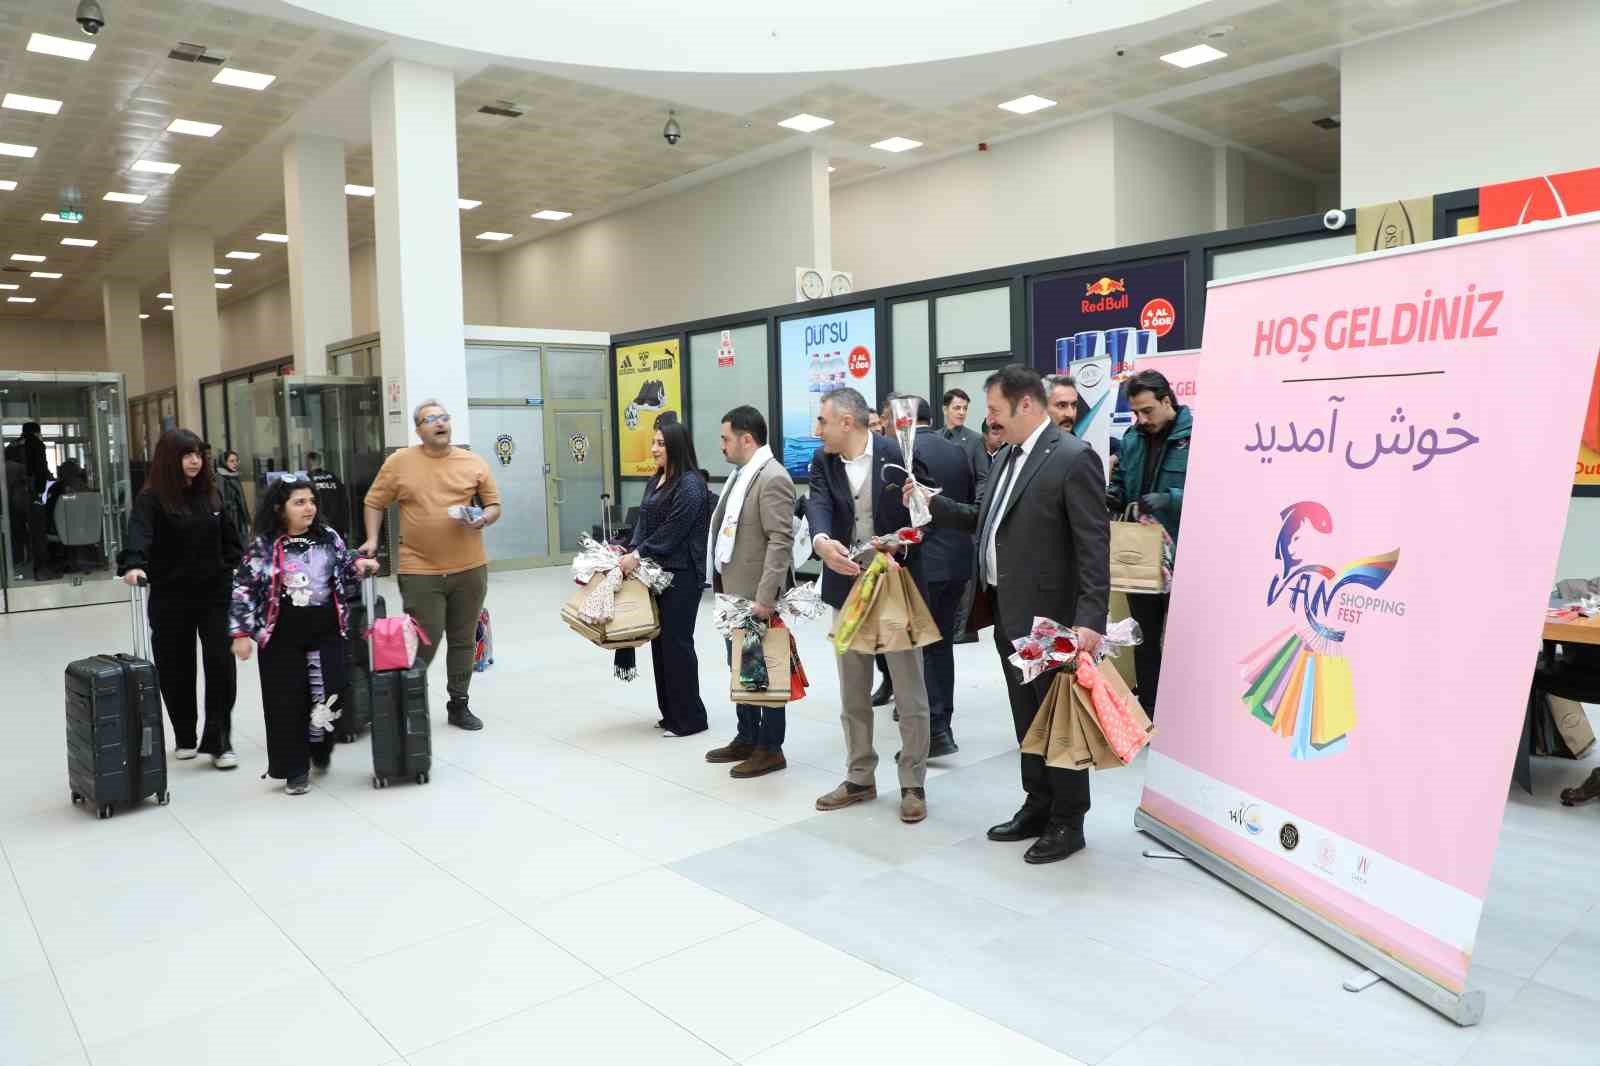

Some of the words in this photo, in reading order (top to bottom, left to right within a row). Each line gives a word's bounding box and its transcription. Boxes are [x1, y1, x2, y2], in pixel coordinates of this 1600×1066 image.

[1081, 297, 1105, 313] Red
[1105, 294, 1129, 310] Bull
[1146, 309, 1154, 318] 4
[1155, 307, 1169, 317] AL
[1151, 316, 1173, 327] ÖDE
[1253, 313, 1319, 363] HOŞ
[1324, 283, 1505, 351] GELDİNİZ
[857, 353, 867, 362] AL
[1244, 395, 1345, 464] آمدید
[1345, 406, 1480, 471] خوش
[1338, 592, 1407, 617] SHOPPING
[1336, 607, 1363, 625] FEST
